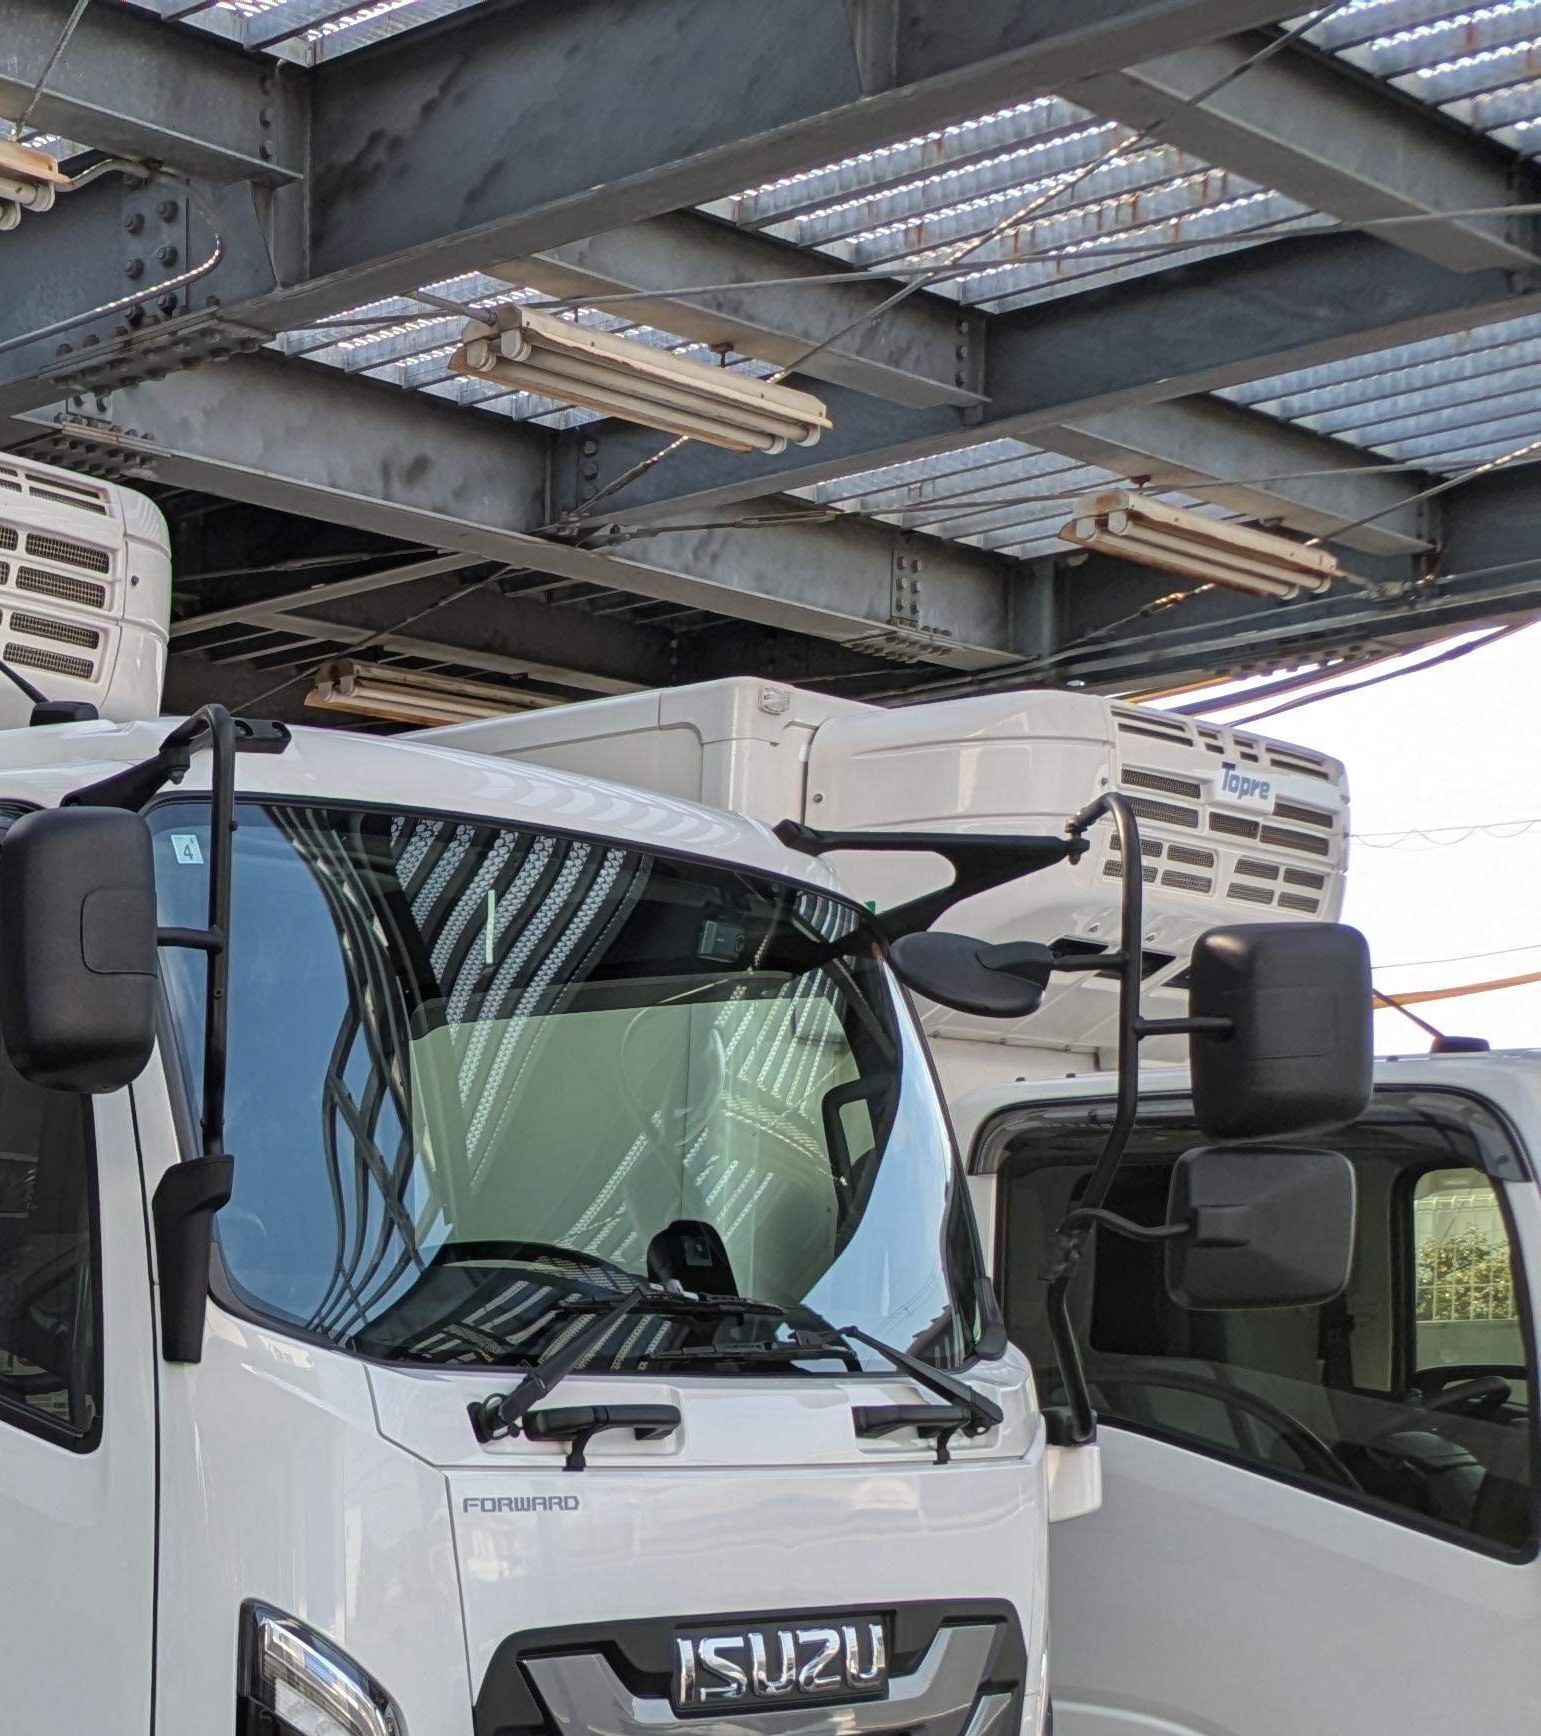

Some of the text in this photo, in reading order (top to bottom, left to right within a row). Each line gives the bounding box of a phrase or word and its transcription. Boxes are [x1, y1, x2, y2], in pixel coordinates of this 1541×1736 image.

[1221, 761, 1270, 800] Topre
[183, 844, 194, 861] 4
[462, 1495, 580, 1513] FORWARD
[676, 1623, 886, 1706] ISUZU
